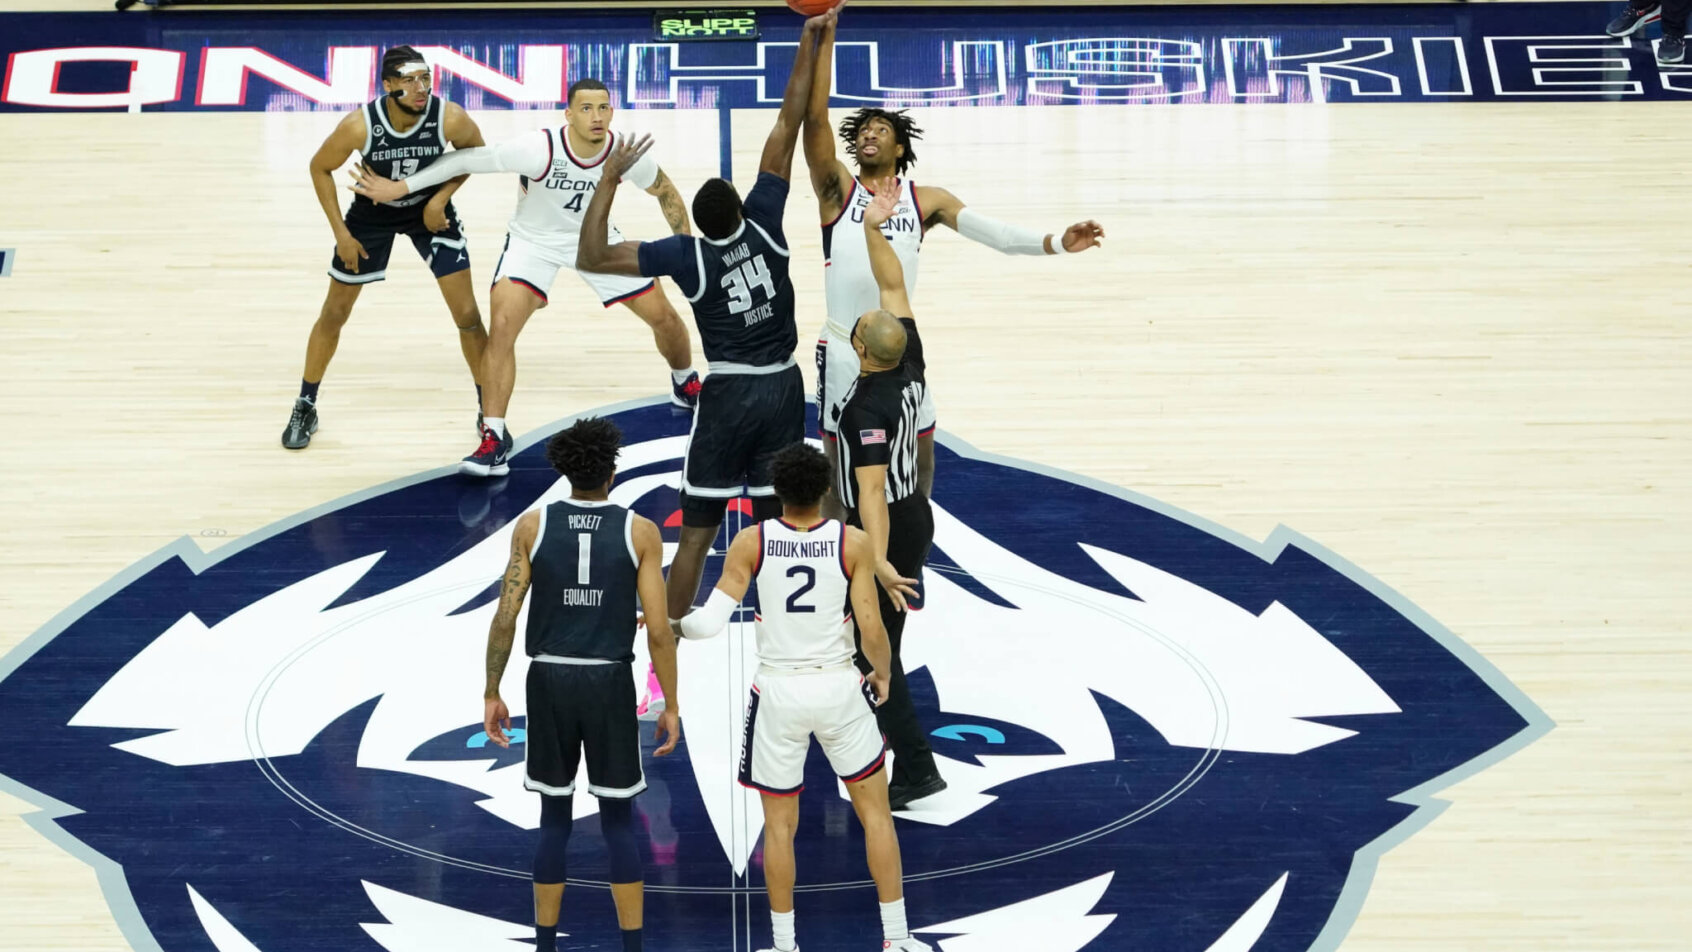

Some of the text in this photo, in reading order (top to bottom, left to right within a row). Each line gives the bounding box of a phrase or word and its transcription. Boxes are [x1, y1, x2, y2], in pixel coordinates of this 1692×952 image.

[661, 18, 755, 29] SLIPP
[627, 35, 1692, 103] HUSKIE
[371, 146, 440, 161] GEORGETOWN
[545, 179, 598, 192] UCON
[563, 193, 584, 213] 4
[851, 207, 915, 233] UNN
[721, 242, 751, 268] WAHAB
[720, 253, 777, 315] 34
[743, 301, 774, 328] JUSTICE
[568, 514, 602, 531] PICKETT
[578, 533, 592, 585] 1
[767, 539, 836, 558] BOUKNIGHT
[563, 588, 604, 607] EQUALITY
[785, 565, 816, 613] 2
